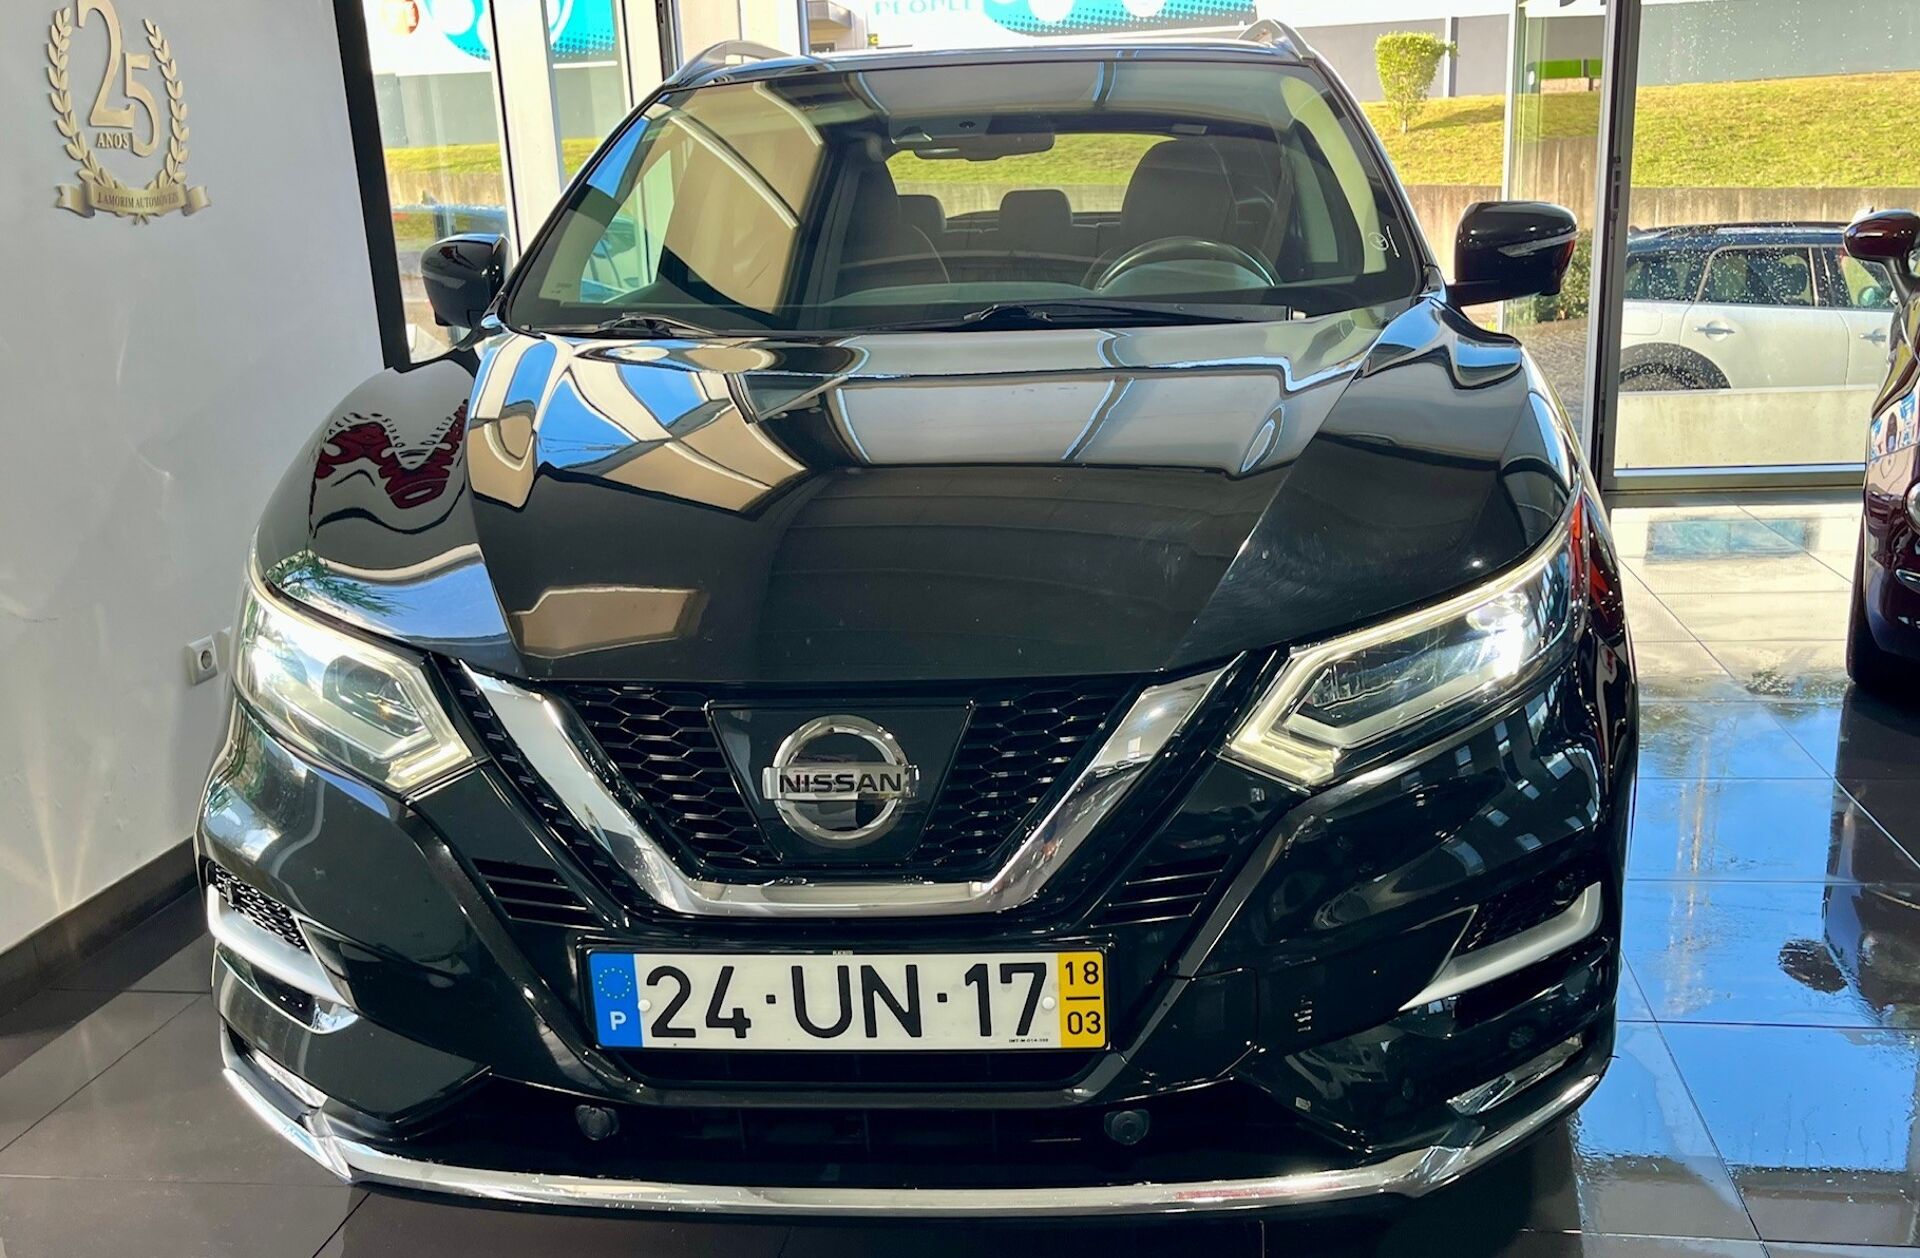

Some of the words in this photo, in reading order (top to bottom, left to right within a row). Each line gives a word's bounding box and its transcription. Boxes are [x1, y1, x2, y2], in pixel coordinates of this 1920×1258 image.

[77, 0, 162, 157] 25
[96, 133, 130, 149] ANOS
[104, 194, 134, 209] AMORIM
[779, 772, 901, 793] NISSAN
[1064, 961, 1100, 986] 18
[609, 1010, 628, 1031] P
[1067, 1010, 1103, 1036] 03
